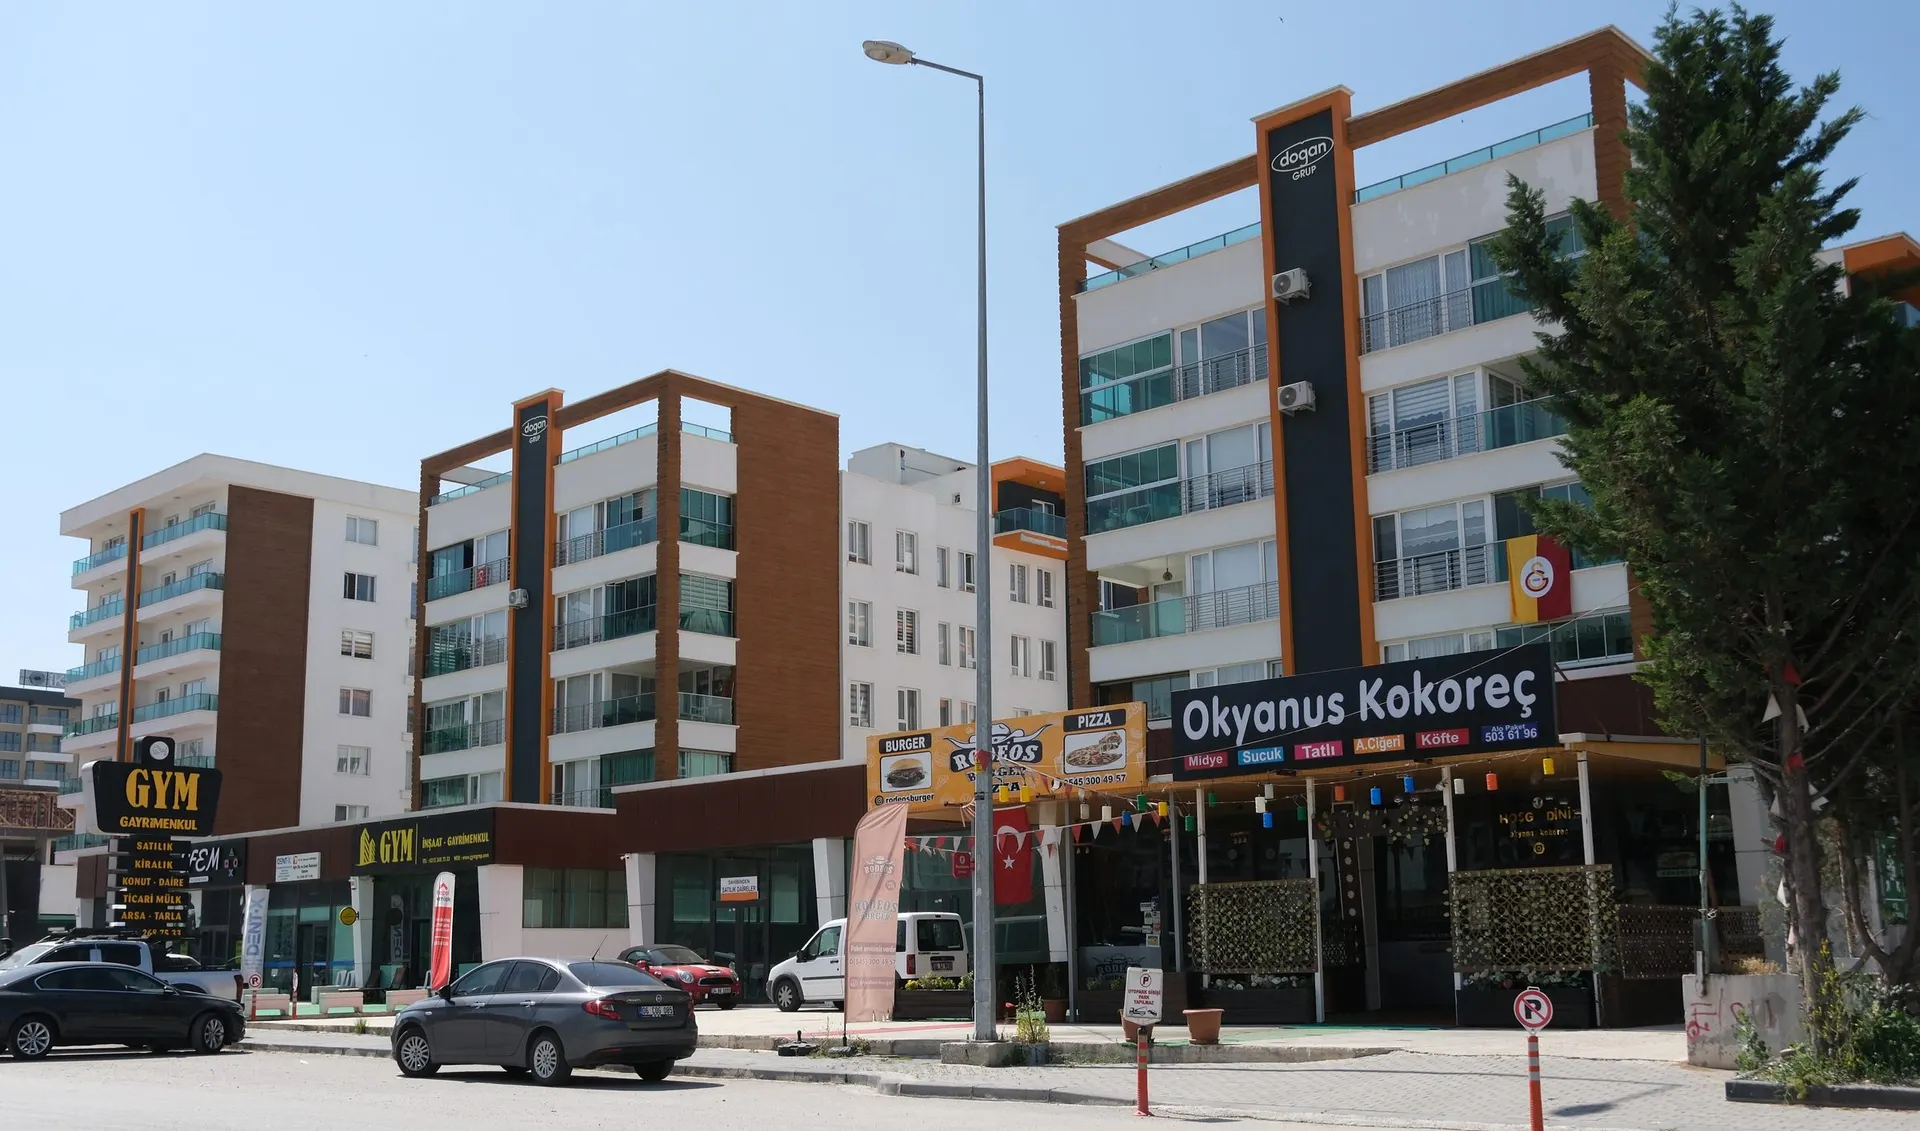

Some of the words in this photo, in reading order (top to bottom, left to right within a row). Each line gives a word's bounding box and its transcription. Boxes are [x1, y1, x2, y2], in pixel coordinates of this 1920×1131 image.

[1279, 141, 1328, 168] dogan
[1292, 165, 1317, 181] GRUP
[1183, 692, 1345, 746] Okyanus
[1359, 669, 1537, 721] Kokoreç
[1077, 713, 1112, 729] PIZZA
[1491, 726, 1507, 735] Alo
[1507, 723, 1526, 734] Paket
[1355, 735, 1401, 752] A.Ciğeri
[1421, 733, 1460, 746] Köfte
[1485, 732, 1506, 744] 503
[1508, 729, 1524, 742] 61
[1526, 727, 1538, 741] 96
[885, 736, 926, 754] BURGER
[1302, 743, 1336, 759] Tatlı
[1188, 753, 1224, 768] Midye
[1242, 748, 1282, 763] Sucuk
[1085, 776, 1101, 785] 300
[1103, 774, 1114, 784] 49
[1116, 773, 1126, 783] 57
[125, 768, 200, 811] GYM
[136, 841, 173, 851] SATILIK
[380, 828, 414, 864] GYM
[422, 837, 443, 851] İNŞAAT
[447, 832, 489, 846] GAYRİMENKUL
[134, 858, 173, 869] KİRALIK
[122, 876, 151, 886] KONUT
[158, 875, 184, 886] DAİRE
[123, 893, 154, 904] TİCARİ
[155, 893, 182, 904] MÜLK
[121, 911, 146, 920] ARSA
[154, 911, 182, 920] TARLA
